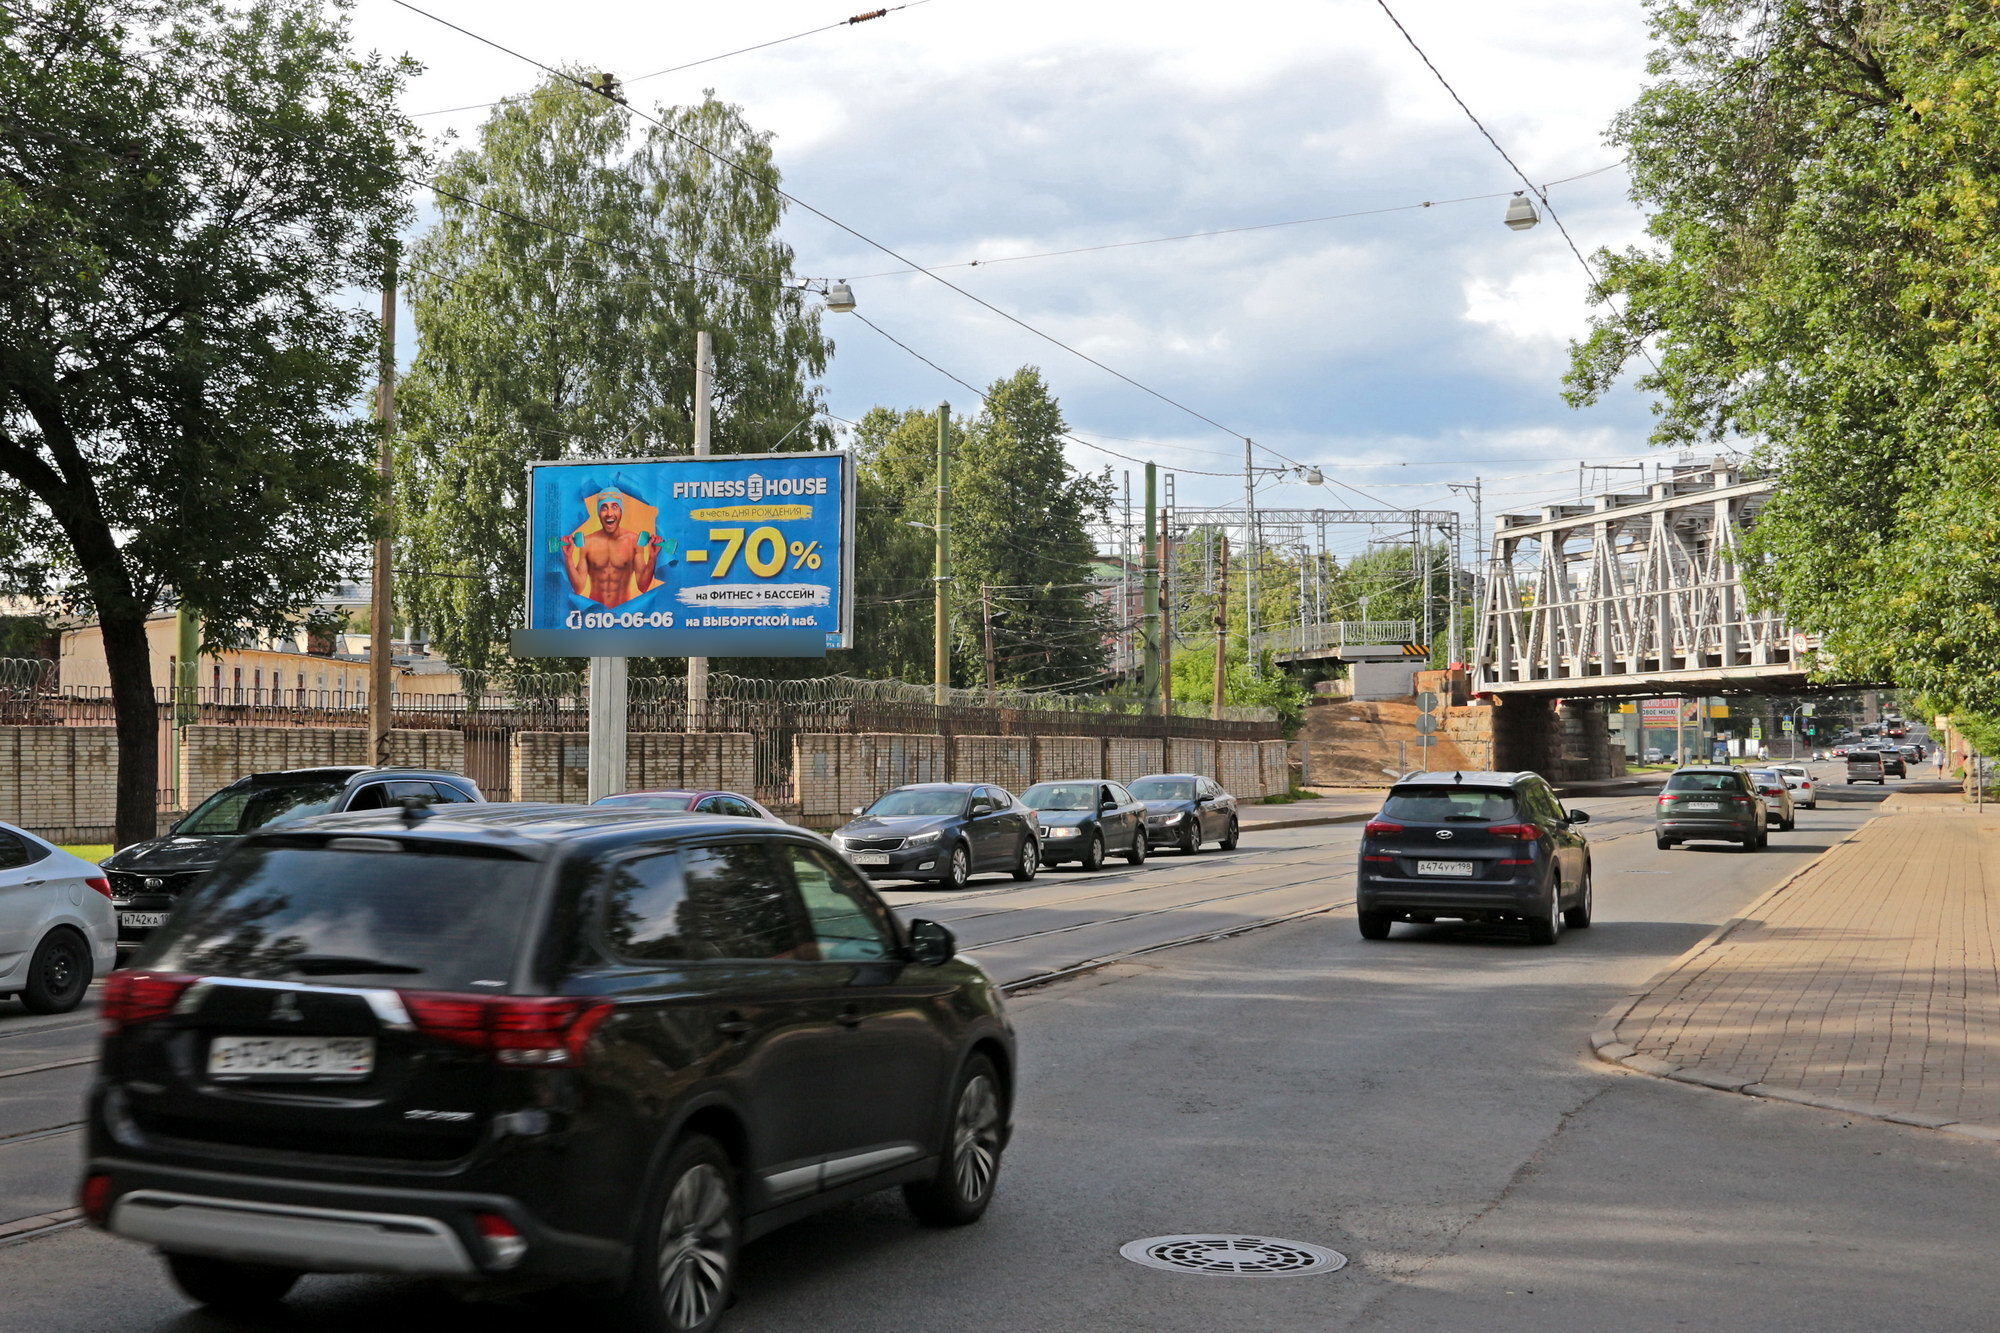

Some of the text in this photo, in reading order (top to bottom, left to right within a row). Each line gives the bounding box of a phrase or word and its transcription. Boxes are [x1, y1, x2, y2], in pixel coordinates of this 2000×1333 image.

[673, 477, 827, 499] FITNESS HOUSE
[706, 510, 730, 518] честь
[731, 508, 750, 518] ДНЯ
[751, 507, 802, 518] РОЖДЕНИЯ
[695, 593, 708, 601] на
[709, 590, 754, 601] ФИТНЕС
[764, 588, 816, 600] БАССЕЙН
[584, 611, 674, 629] 610-06-06
[685, 613, 818, 628] на ВЫБОРГСКОЙ наб.
